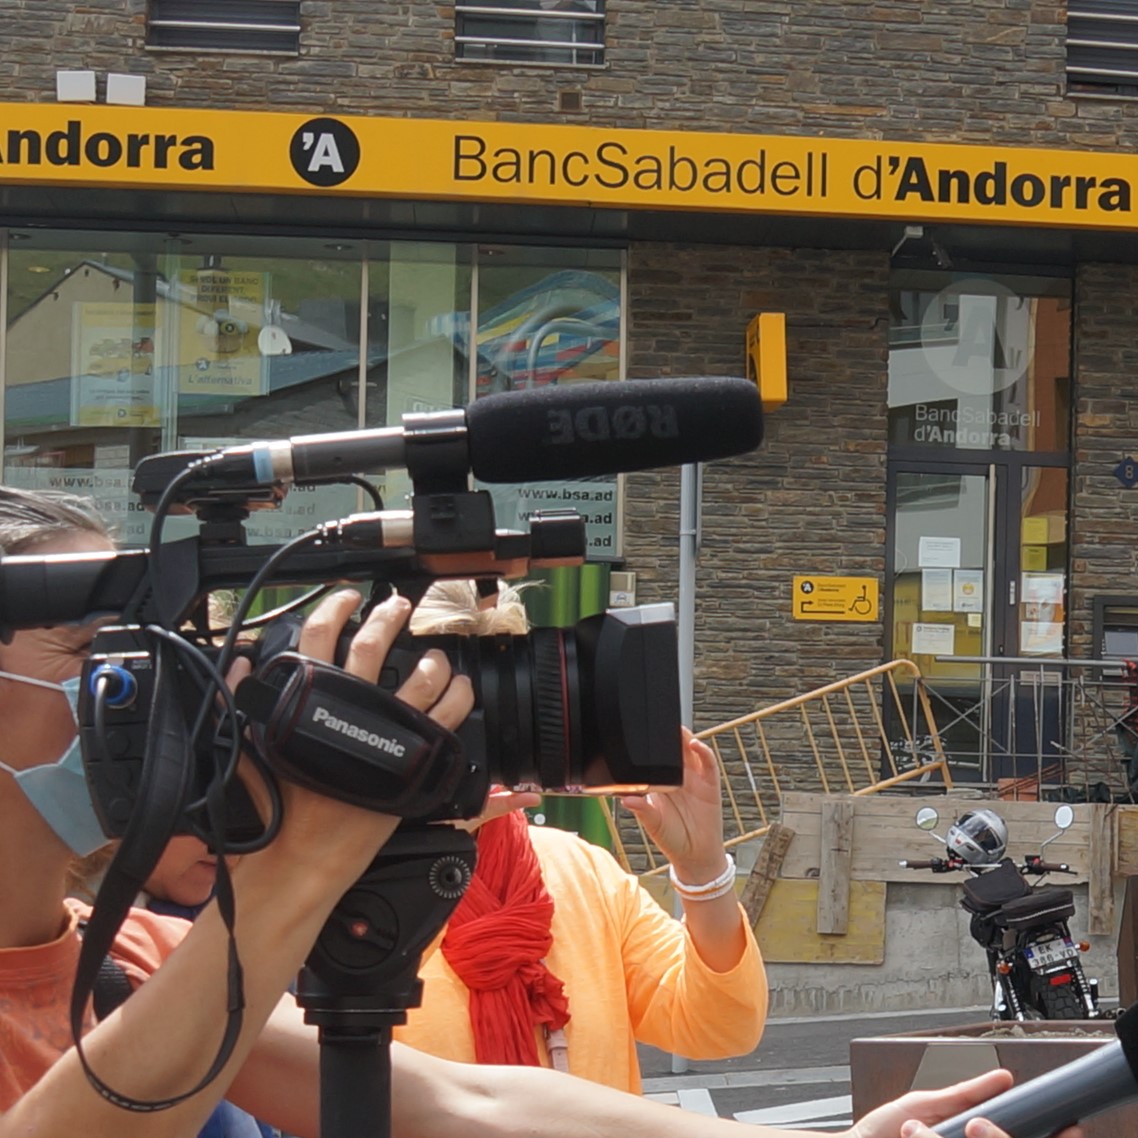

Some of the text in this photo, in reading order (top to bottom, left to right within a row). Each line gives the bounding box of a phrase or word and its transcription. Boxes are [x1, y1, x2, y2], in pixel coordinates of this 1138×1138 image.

[0, 119, 215, 171] ndorra
[453, 134, 1131, 212] BancSabadell d'Andorra
[544, 404, 680, 445] RØDE
[914, 425, 1011, 447] d'Andorra
[915, 404, 1041, 428] BancSabadell
[518, 488, 613, 501] www.bsa.ad
[312, 706, 406, 758] Panasonic
